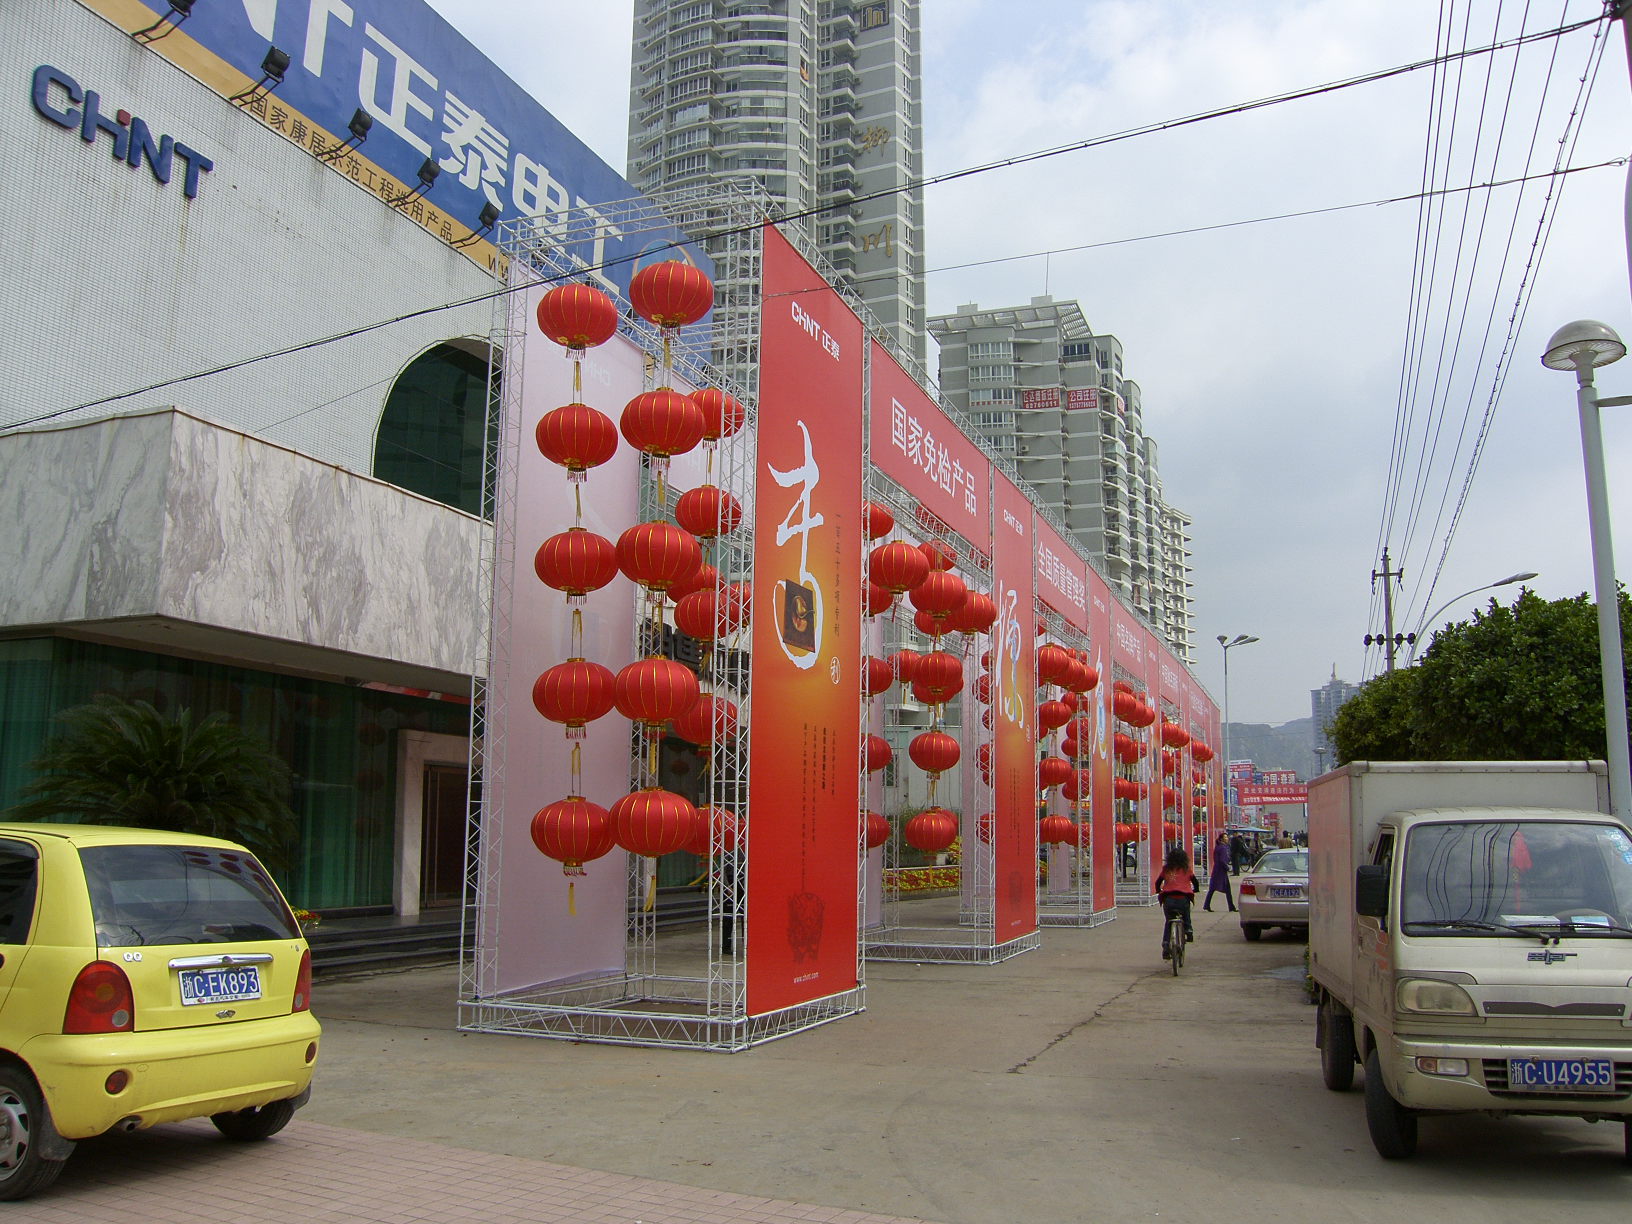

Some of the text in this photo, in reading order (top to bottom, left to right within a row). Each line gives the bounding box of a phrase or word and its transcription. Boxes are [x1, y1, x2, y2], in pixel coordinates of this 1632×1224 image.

[33, 64, 214, 199] CHNT
[359, 22, 623, 294] 正泰电工
[791, 300, 820, 341] CHNT
[822, 329, 840, 362] 正泰
[892, 397, 977, 517] 国家免检产品
[1038, 541, 1086, 613] 全国质量管理奖
[123, 951, 143, 963] QQ
